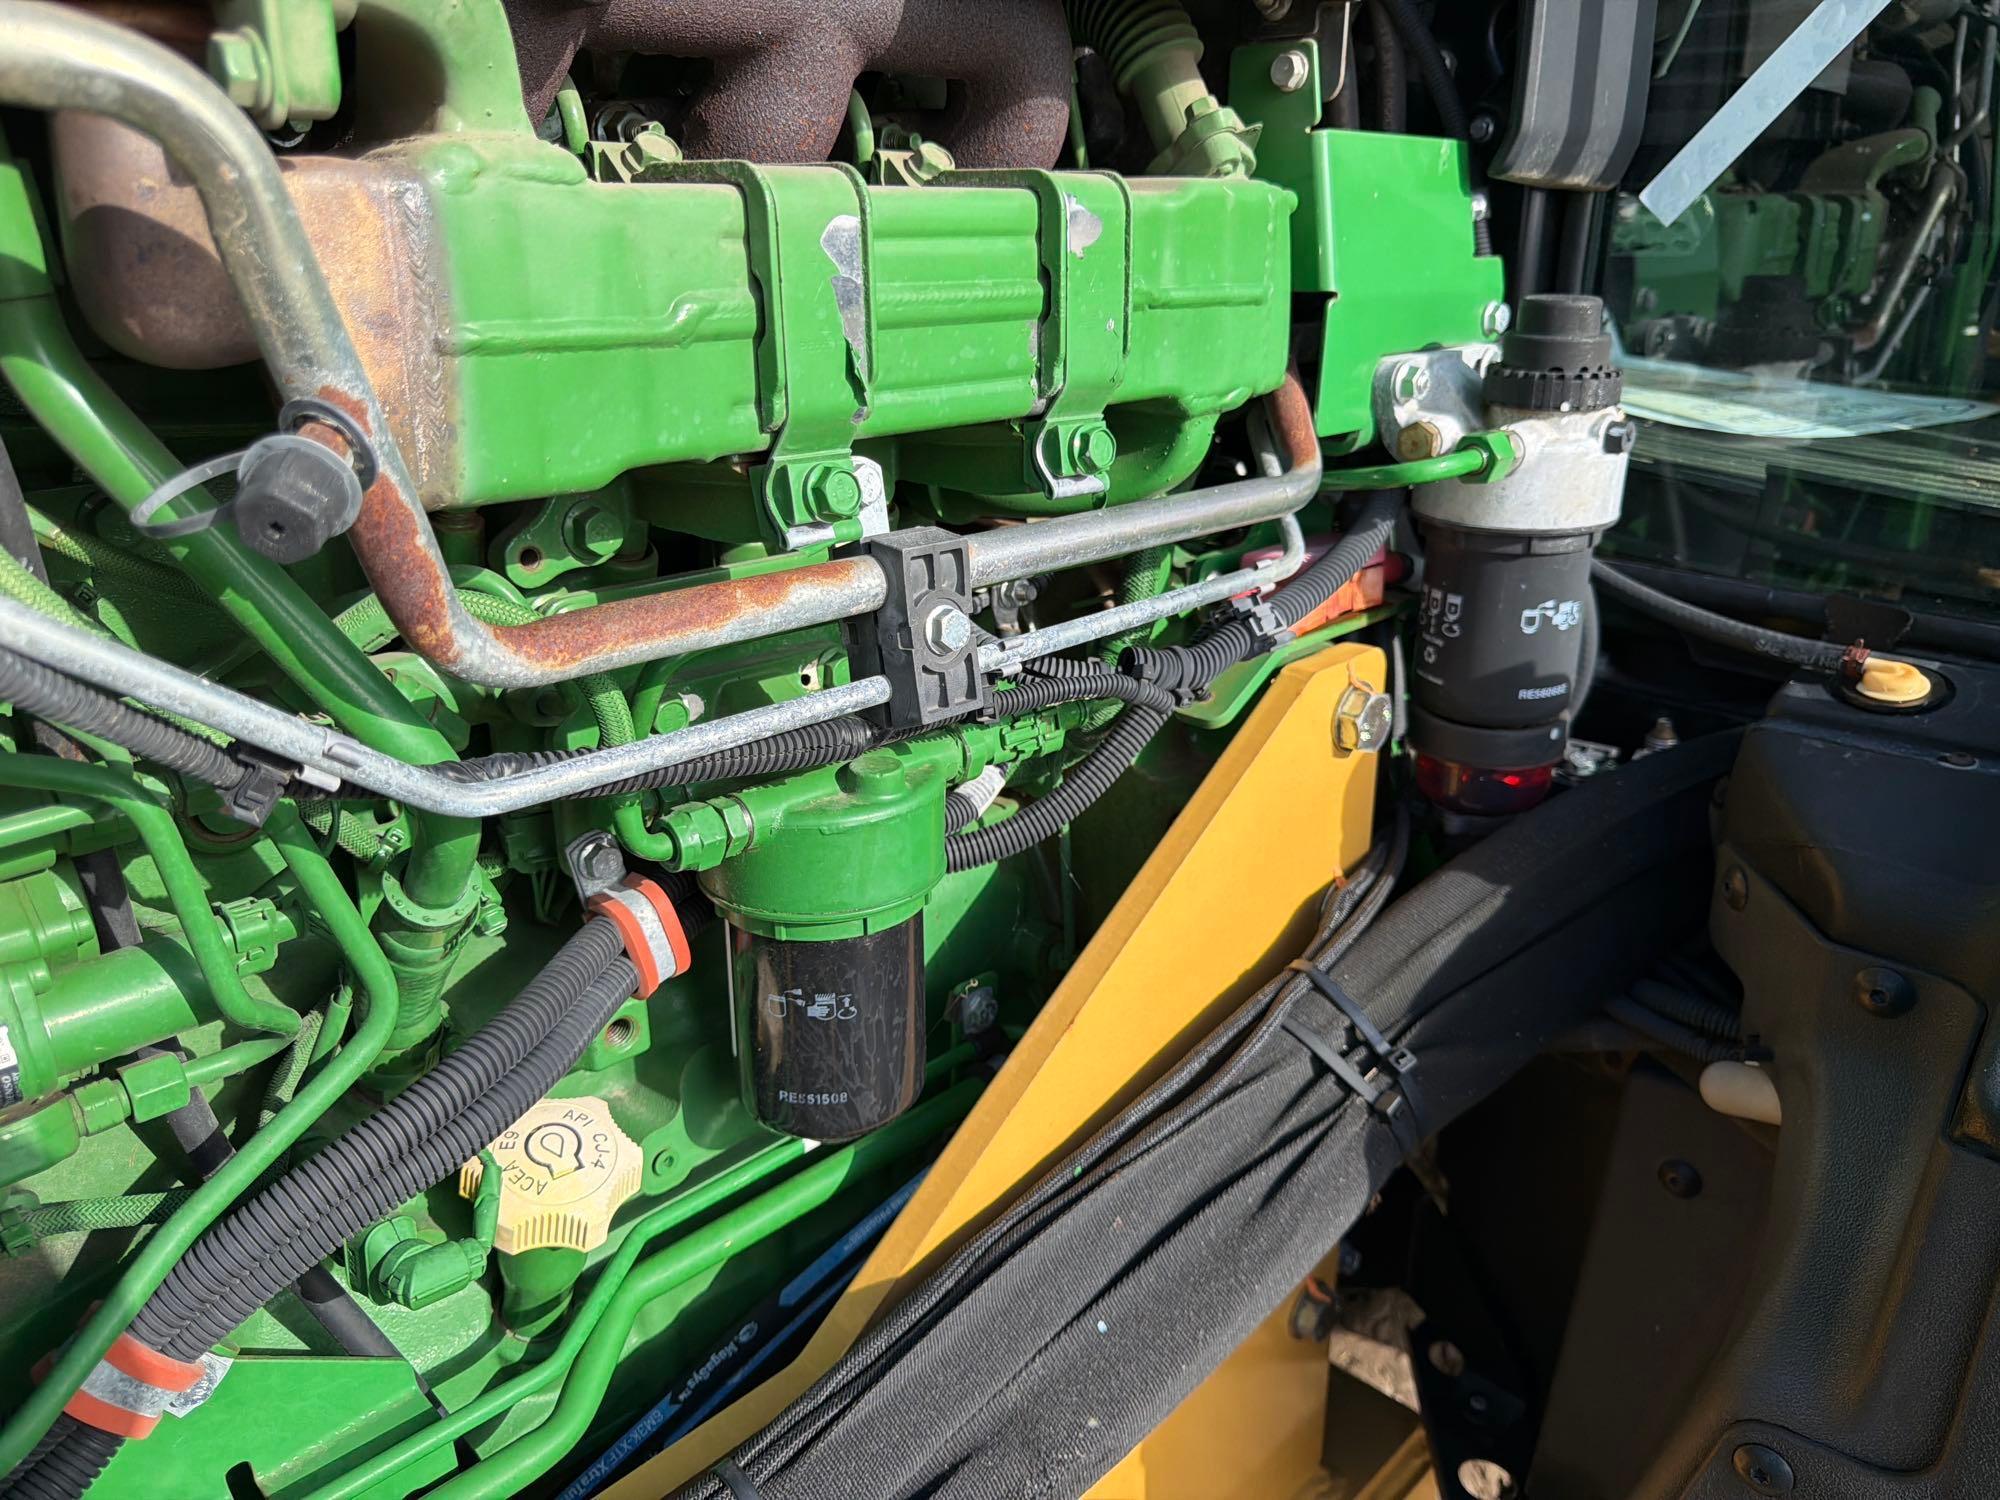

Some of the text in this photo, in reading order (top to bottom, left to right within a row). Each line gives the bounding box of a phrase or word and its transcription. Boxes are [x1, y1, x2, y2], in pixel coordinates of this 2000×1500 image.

[499, 1131, 549, 1196] ACEA E9
[562, 1109, 610, 1170] API CJ-4
